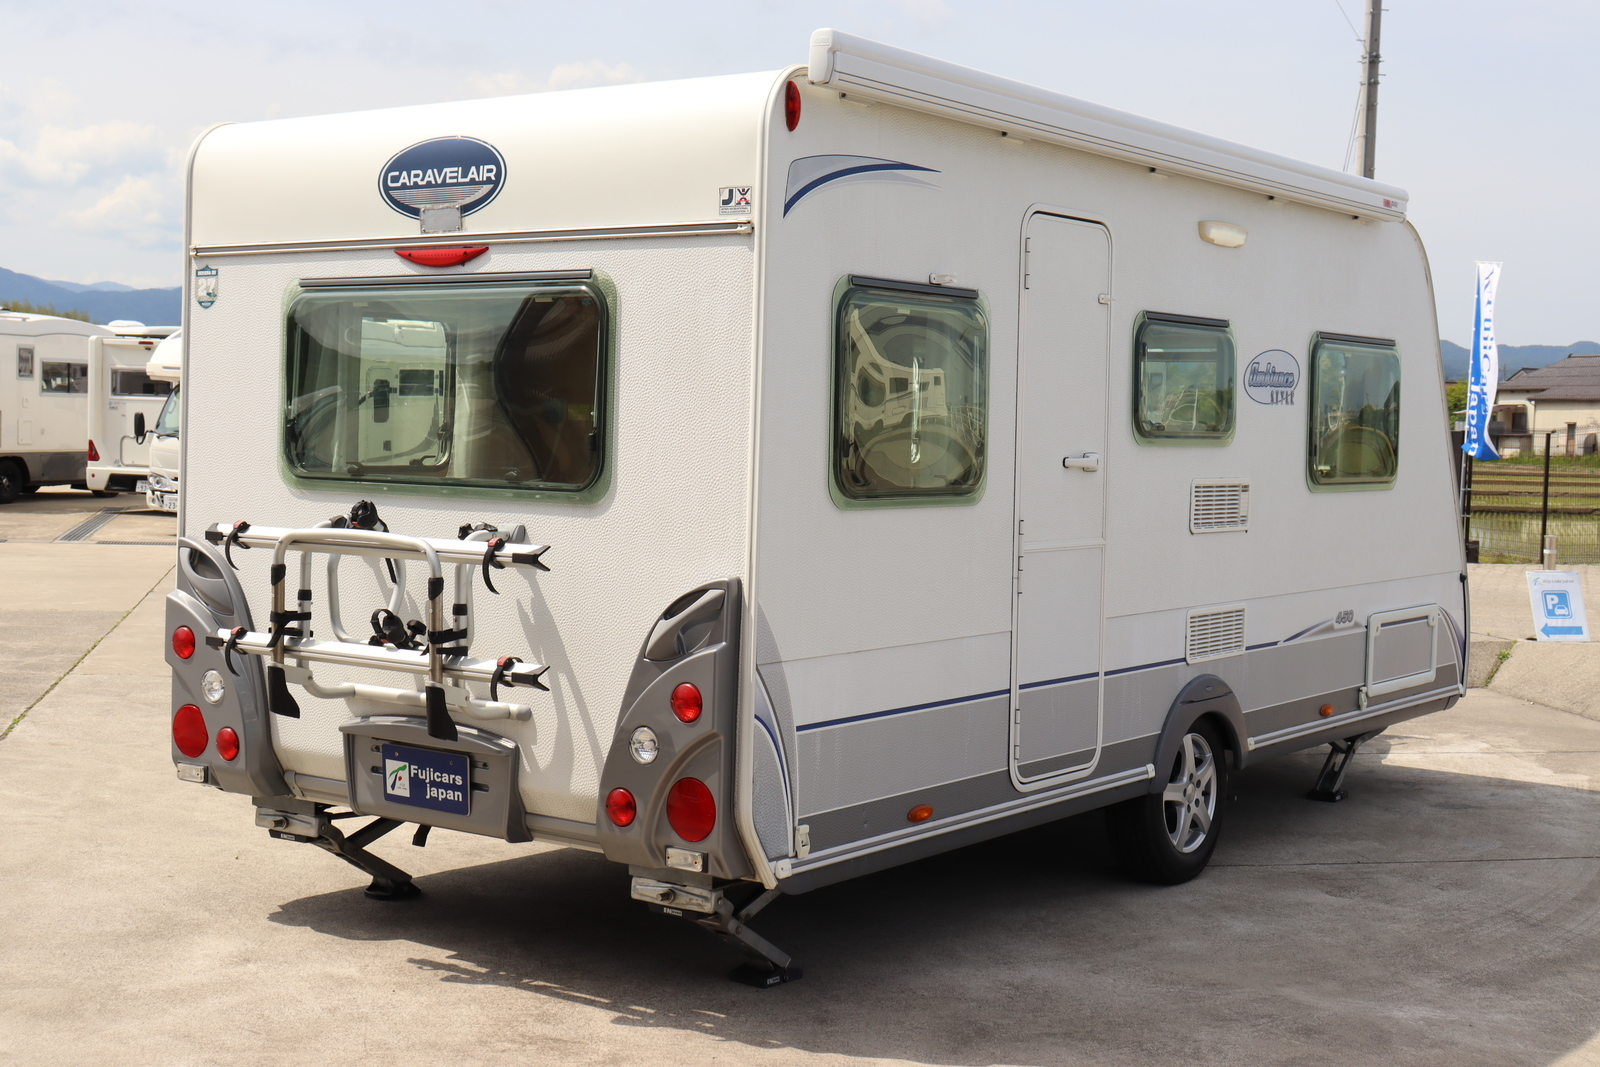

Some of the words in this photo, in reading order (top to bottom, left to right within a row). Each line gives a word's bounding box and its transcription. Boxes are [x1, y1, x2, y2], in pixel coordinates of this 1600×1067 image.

[387, 164, 497, 187] CARAVELAIR
[1270, 389, 1295, 405] STYLE
[1545, 594, 1559, 610] P
[1335, 609, 1354, 624] 450
[410, 765, 463, 785] Fujicars
[426, 783, 463, 802] japan
